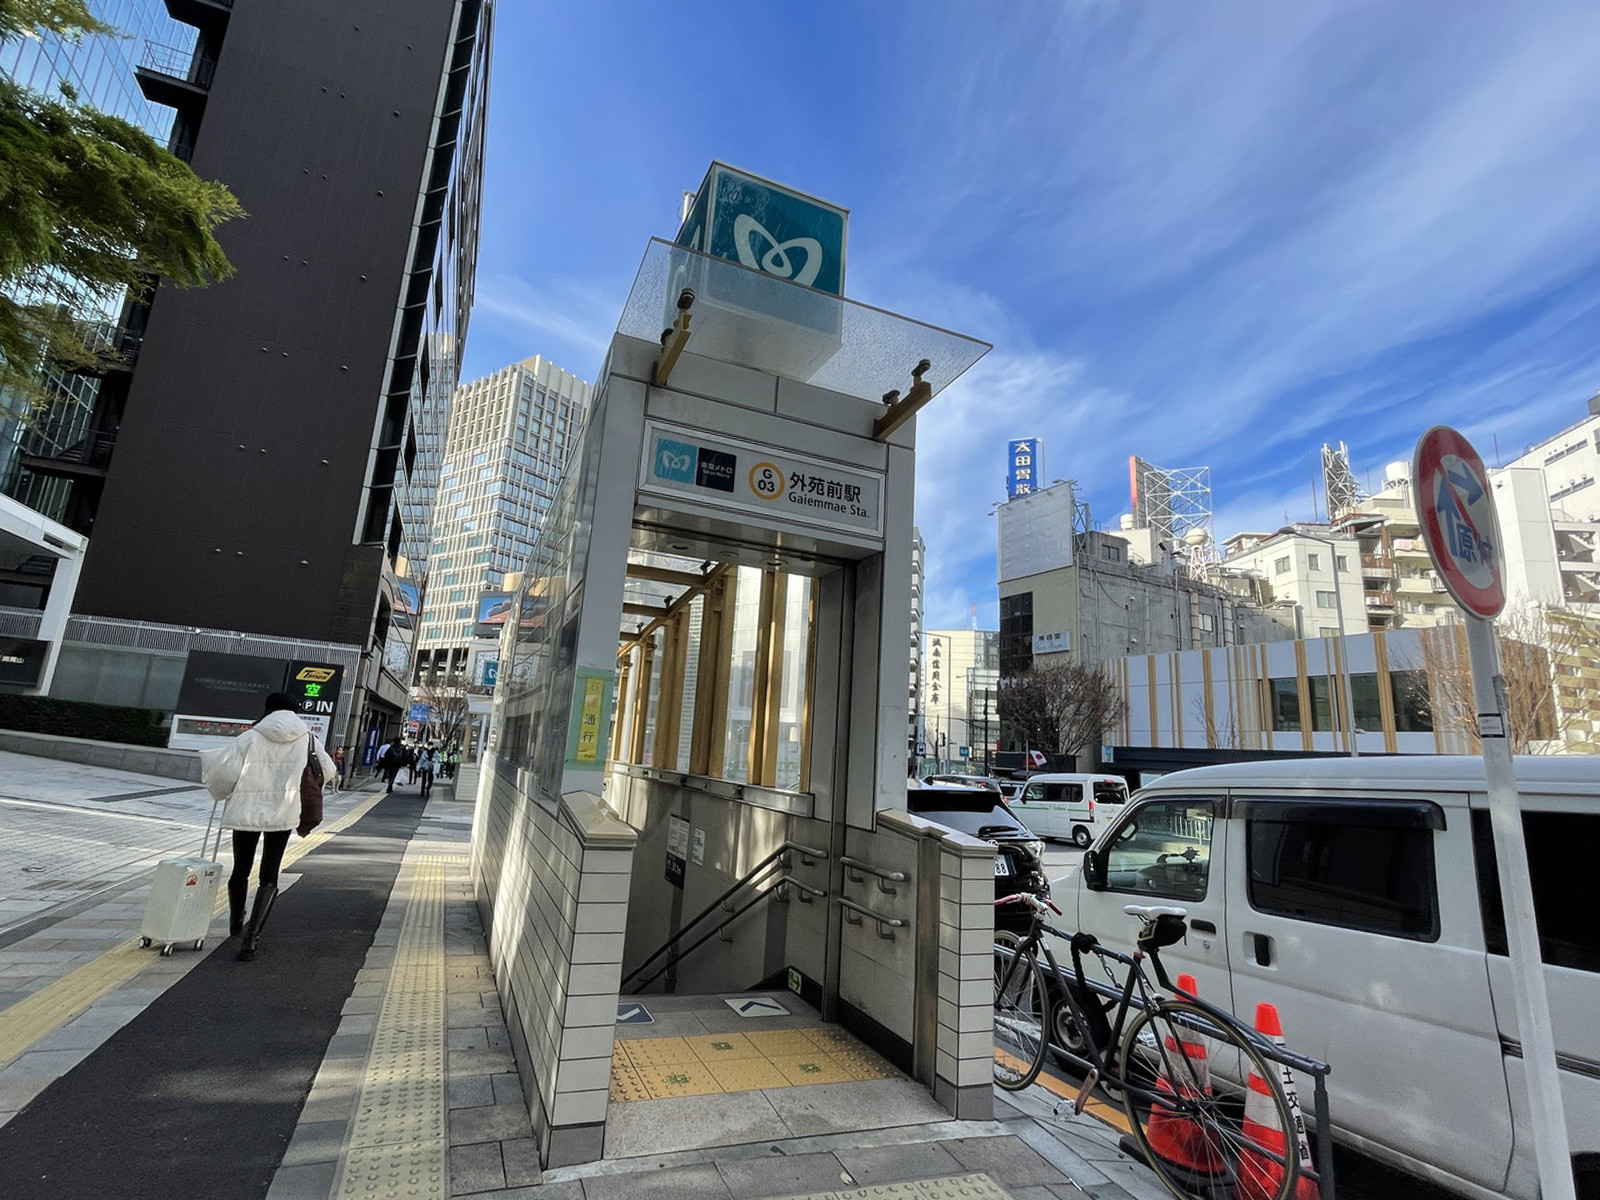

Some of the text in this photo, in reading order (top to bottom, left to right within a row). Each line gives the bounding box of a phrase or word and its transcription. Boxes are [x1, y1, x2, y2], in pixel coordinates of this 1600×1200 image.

[763, 468, 773, 480] G
[757, 479, 775, 493] 03
[789, 472, 861, 504] 外苑前駅
[788, 491, 870, 519] Gaiemmae Sta.
[304, 683, 321, 697] 空
[316, 700, 334, 713] IN
[1276, 1042, 1309, 1160] 土交通省
